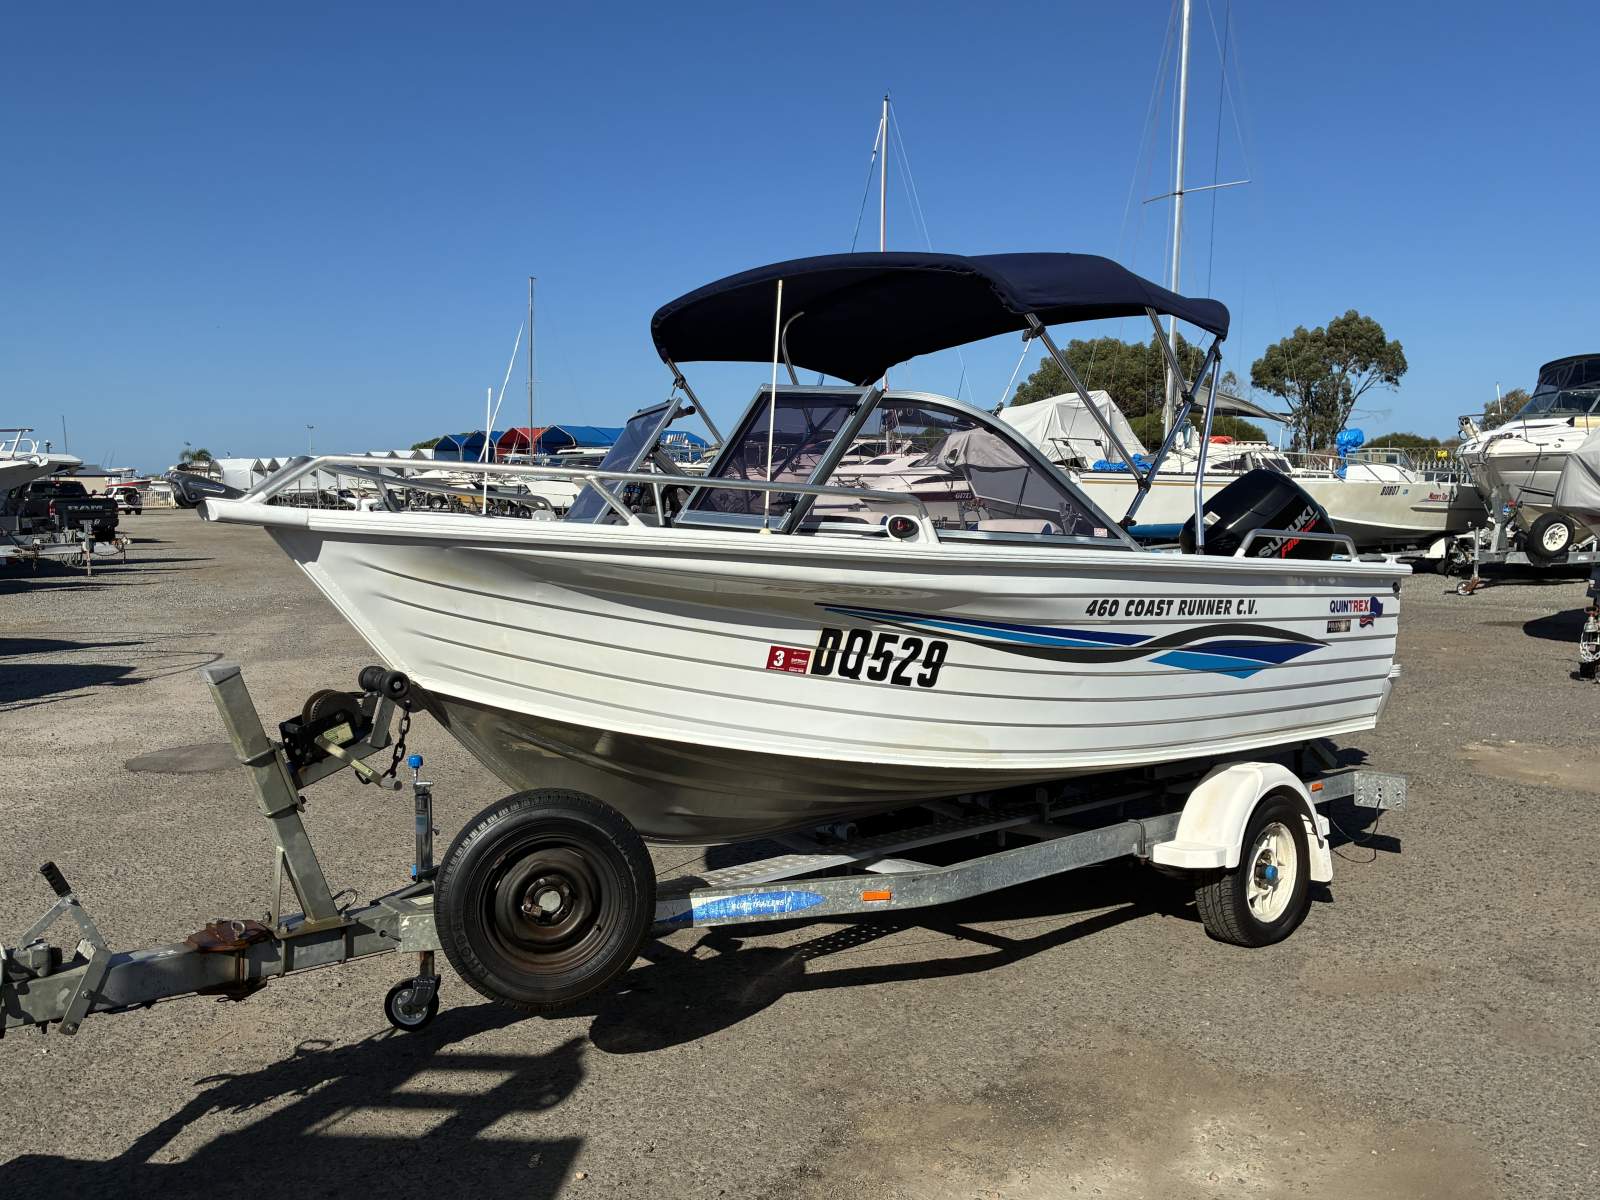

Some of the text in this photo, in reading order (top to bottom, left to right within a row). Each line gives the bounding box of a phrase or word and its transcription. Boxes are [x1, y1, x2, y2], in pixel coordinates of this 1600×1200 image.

[1085, 599, 1258, 617] 460 COAST RUNNER C.V.
[1329, 599, 1369, 614] QUINTREX
[773, 650, 785, 667] 3
[810, 627, 949, 689] DQ529
